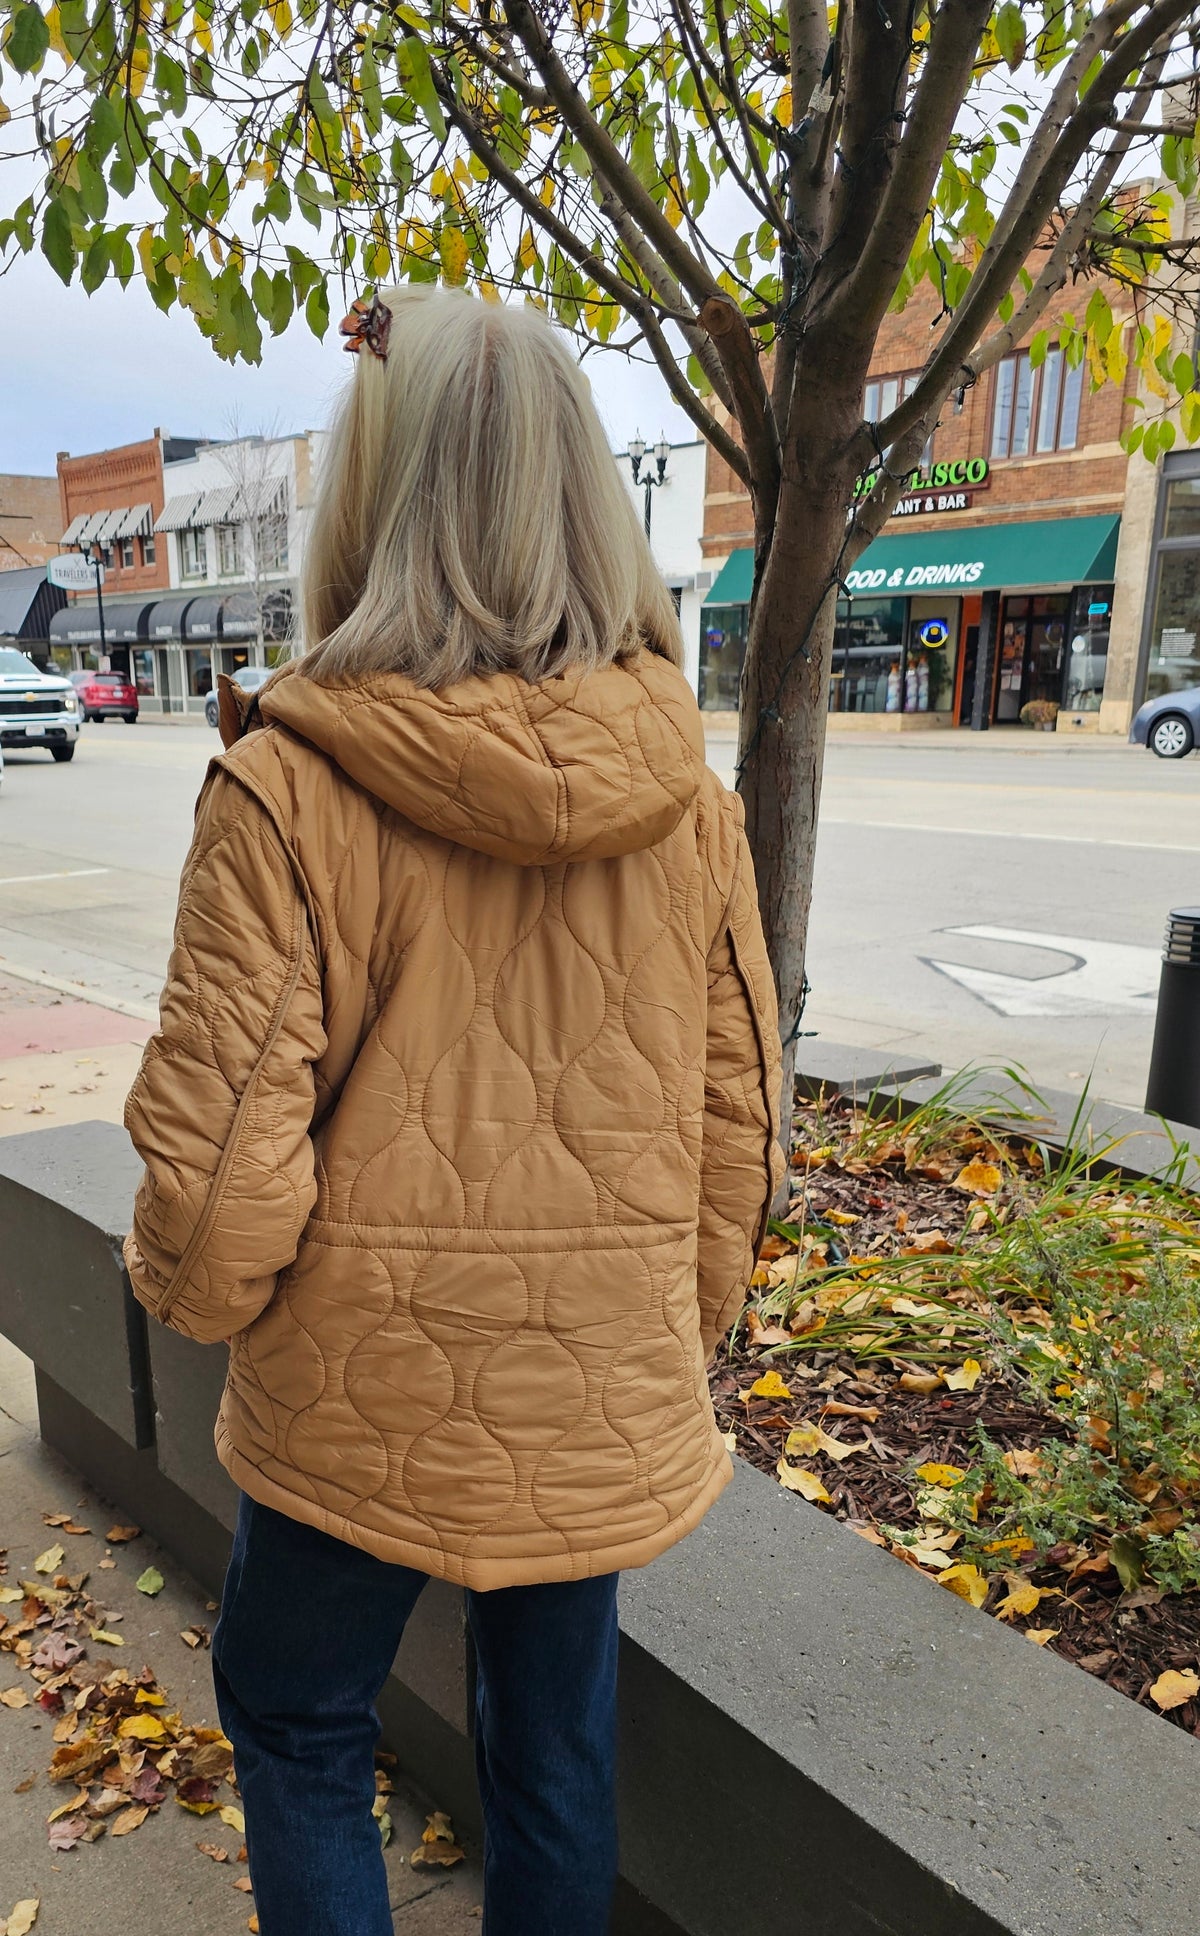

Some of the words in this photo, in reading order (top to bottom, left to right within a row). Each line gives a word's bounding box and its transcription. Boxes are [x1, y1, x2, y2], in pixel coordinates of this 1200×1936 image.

[924, 497, 934, 511] &
[937, 493, 966, 510] BAR
[844, 568, 887, 589] OOD
[886, 568, 904, 587] &
[904, 562, 985, 586] DRINKS
